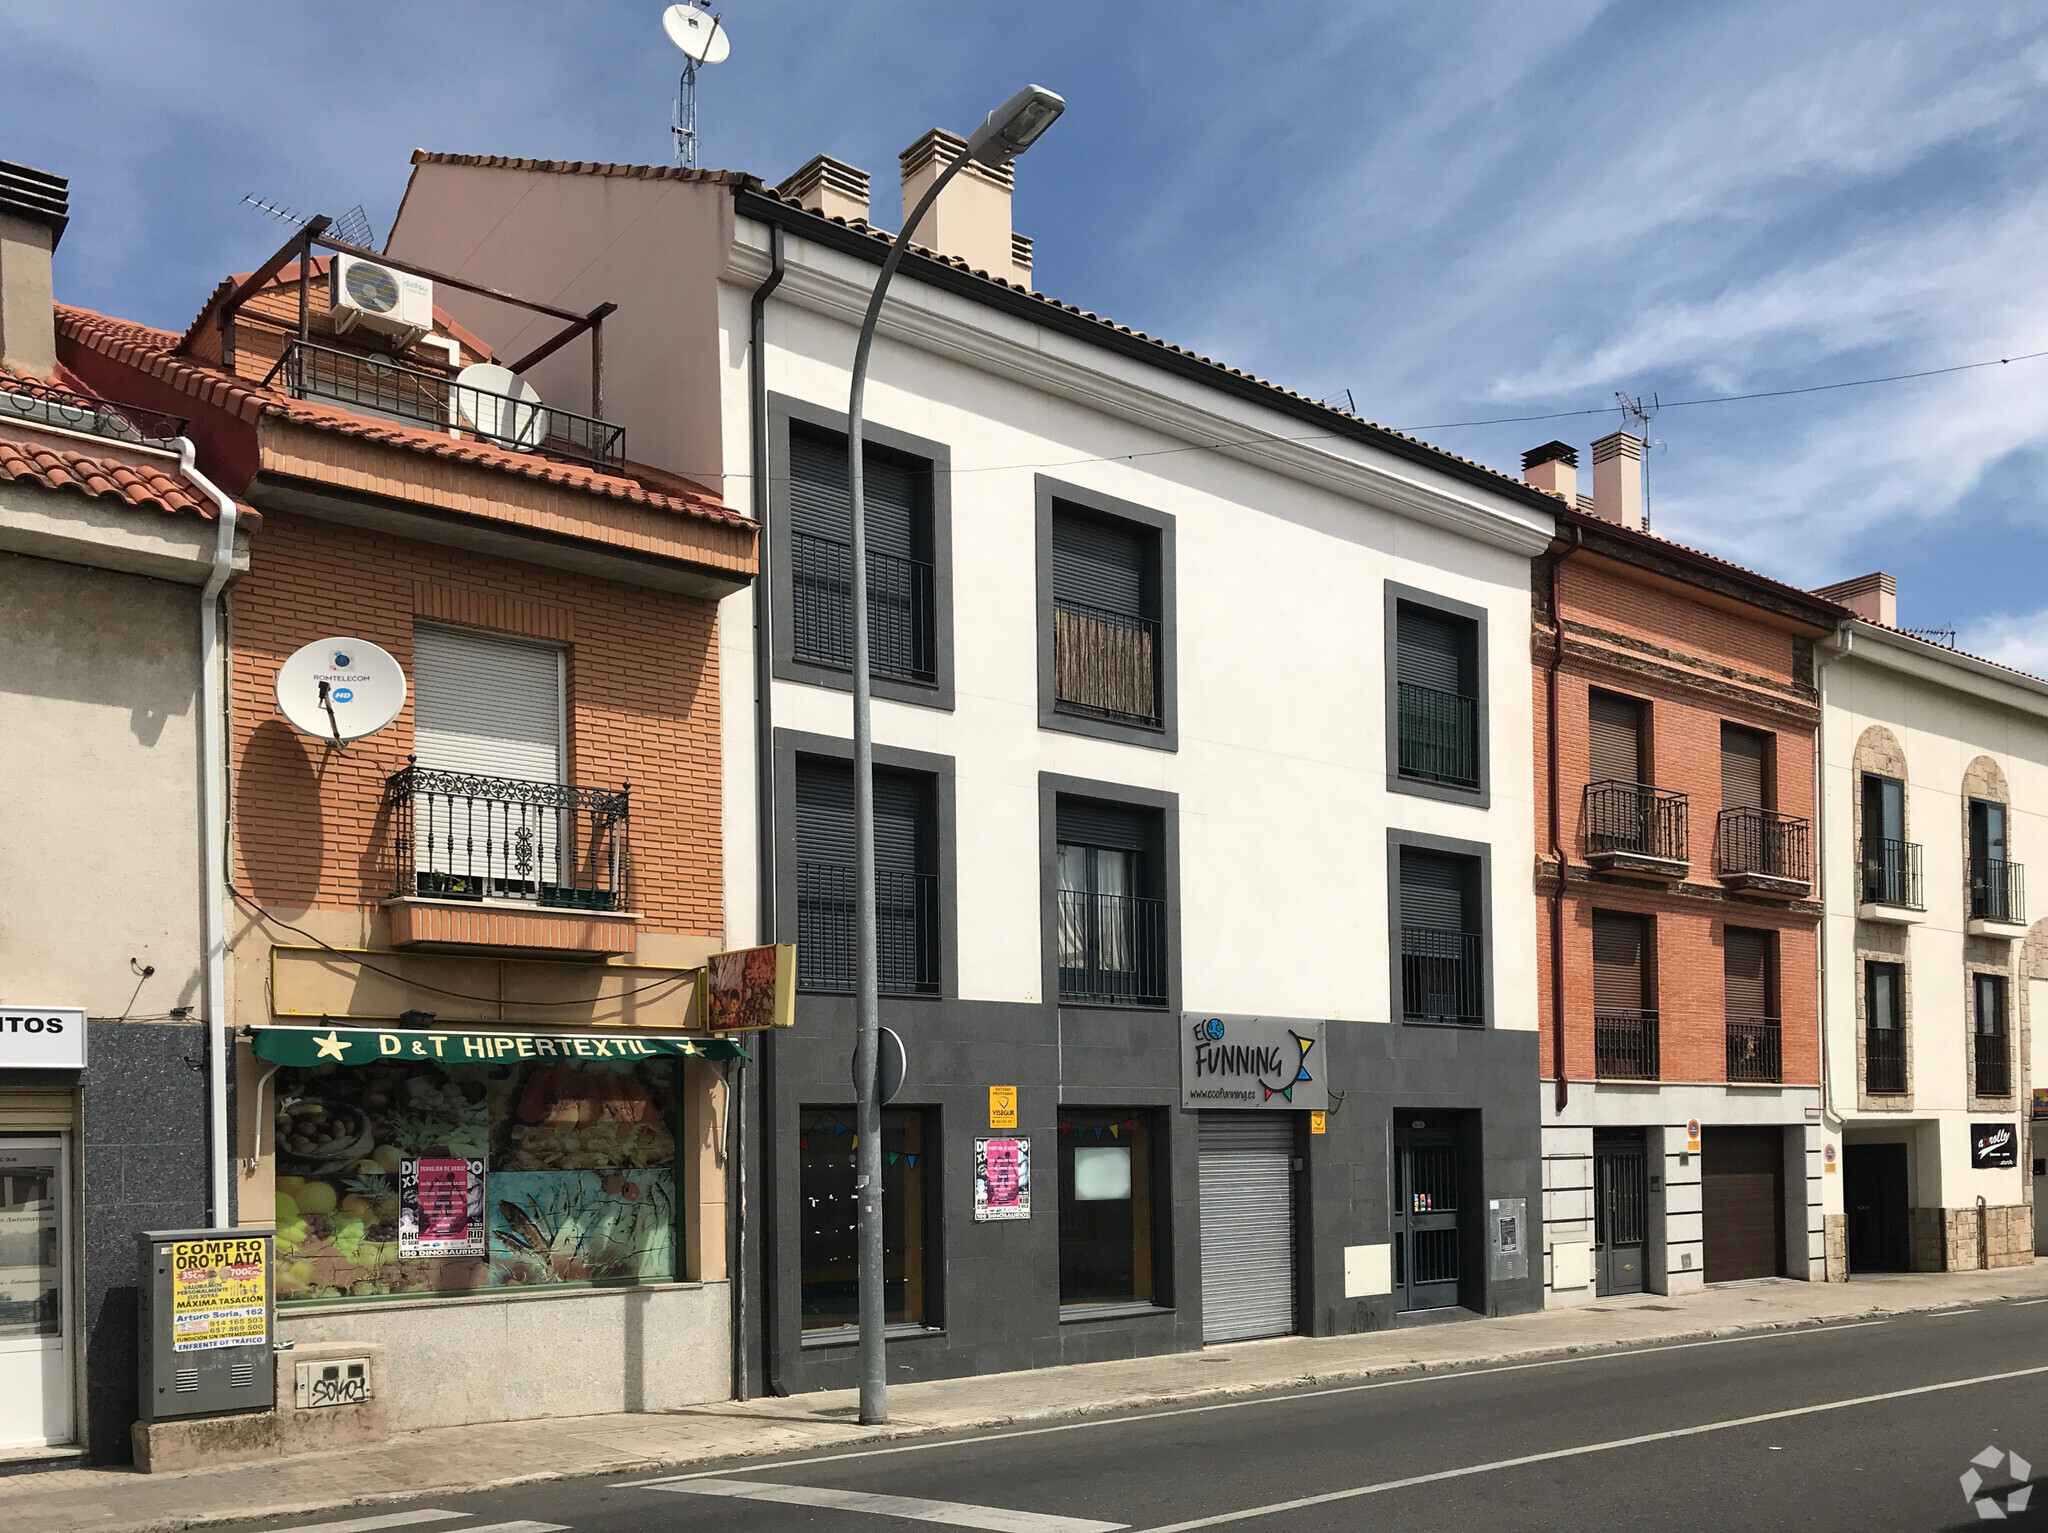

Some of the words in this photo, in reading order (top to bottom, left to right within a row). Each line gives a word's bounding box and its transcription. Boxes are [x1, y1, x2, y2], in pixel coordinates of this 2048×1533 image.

[313, 674, 371, 682] ROMTELECOM
[379, 1034, 402, 1056] D
[411, 1040, 428, 1055] &
[428, 1035, 448, 1057] T
[462, 1036, 657, 1059] HIPERTEXTIL
[1195, 1041, 1283, 1078] FUNNING
[1189, 1087, 1256, 1102] www.ecofunning.es
[992, 1109, 1015, 1117] VISEGUR
[176, 1240, 262, 1256] COMPRO
[418, 1248, 484, 1256] DINOSAURIOS
[176, 1254, 210, 1270] ORO
[215, 1251, 263, 1268] PLATA
[176, 1287, 229, 1296] PERSONALMENTE
[183, 1282, 222, 1290] VALORAMOS
[176, 1299, 217, 1309] MÁXIMA
[219, 1295, 263, 1305] TASACIÓN
[176, 1313, 210, 1323] Arturo
[212, 1310, 242, 1319] Soria,
[245, 1308, 263, 1316] 162
[247, 1316, 263, 1324] 503
[247, 1323, 263, 1331] 500
[176, 1335, 208, 1343] FUNDICIÓN
[219, 1330, 264, 1339] INTERMEDIARIOS
[178, 1341, 218, 1351] ENFRENTE
[231, 1336, 263, 1344] TRÁFICO
